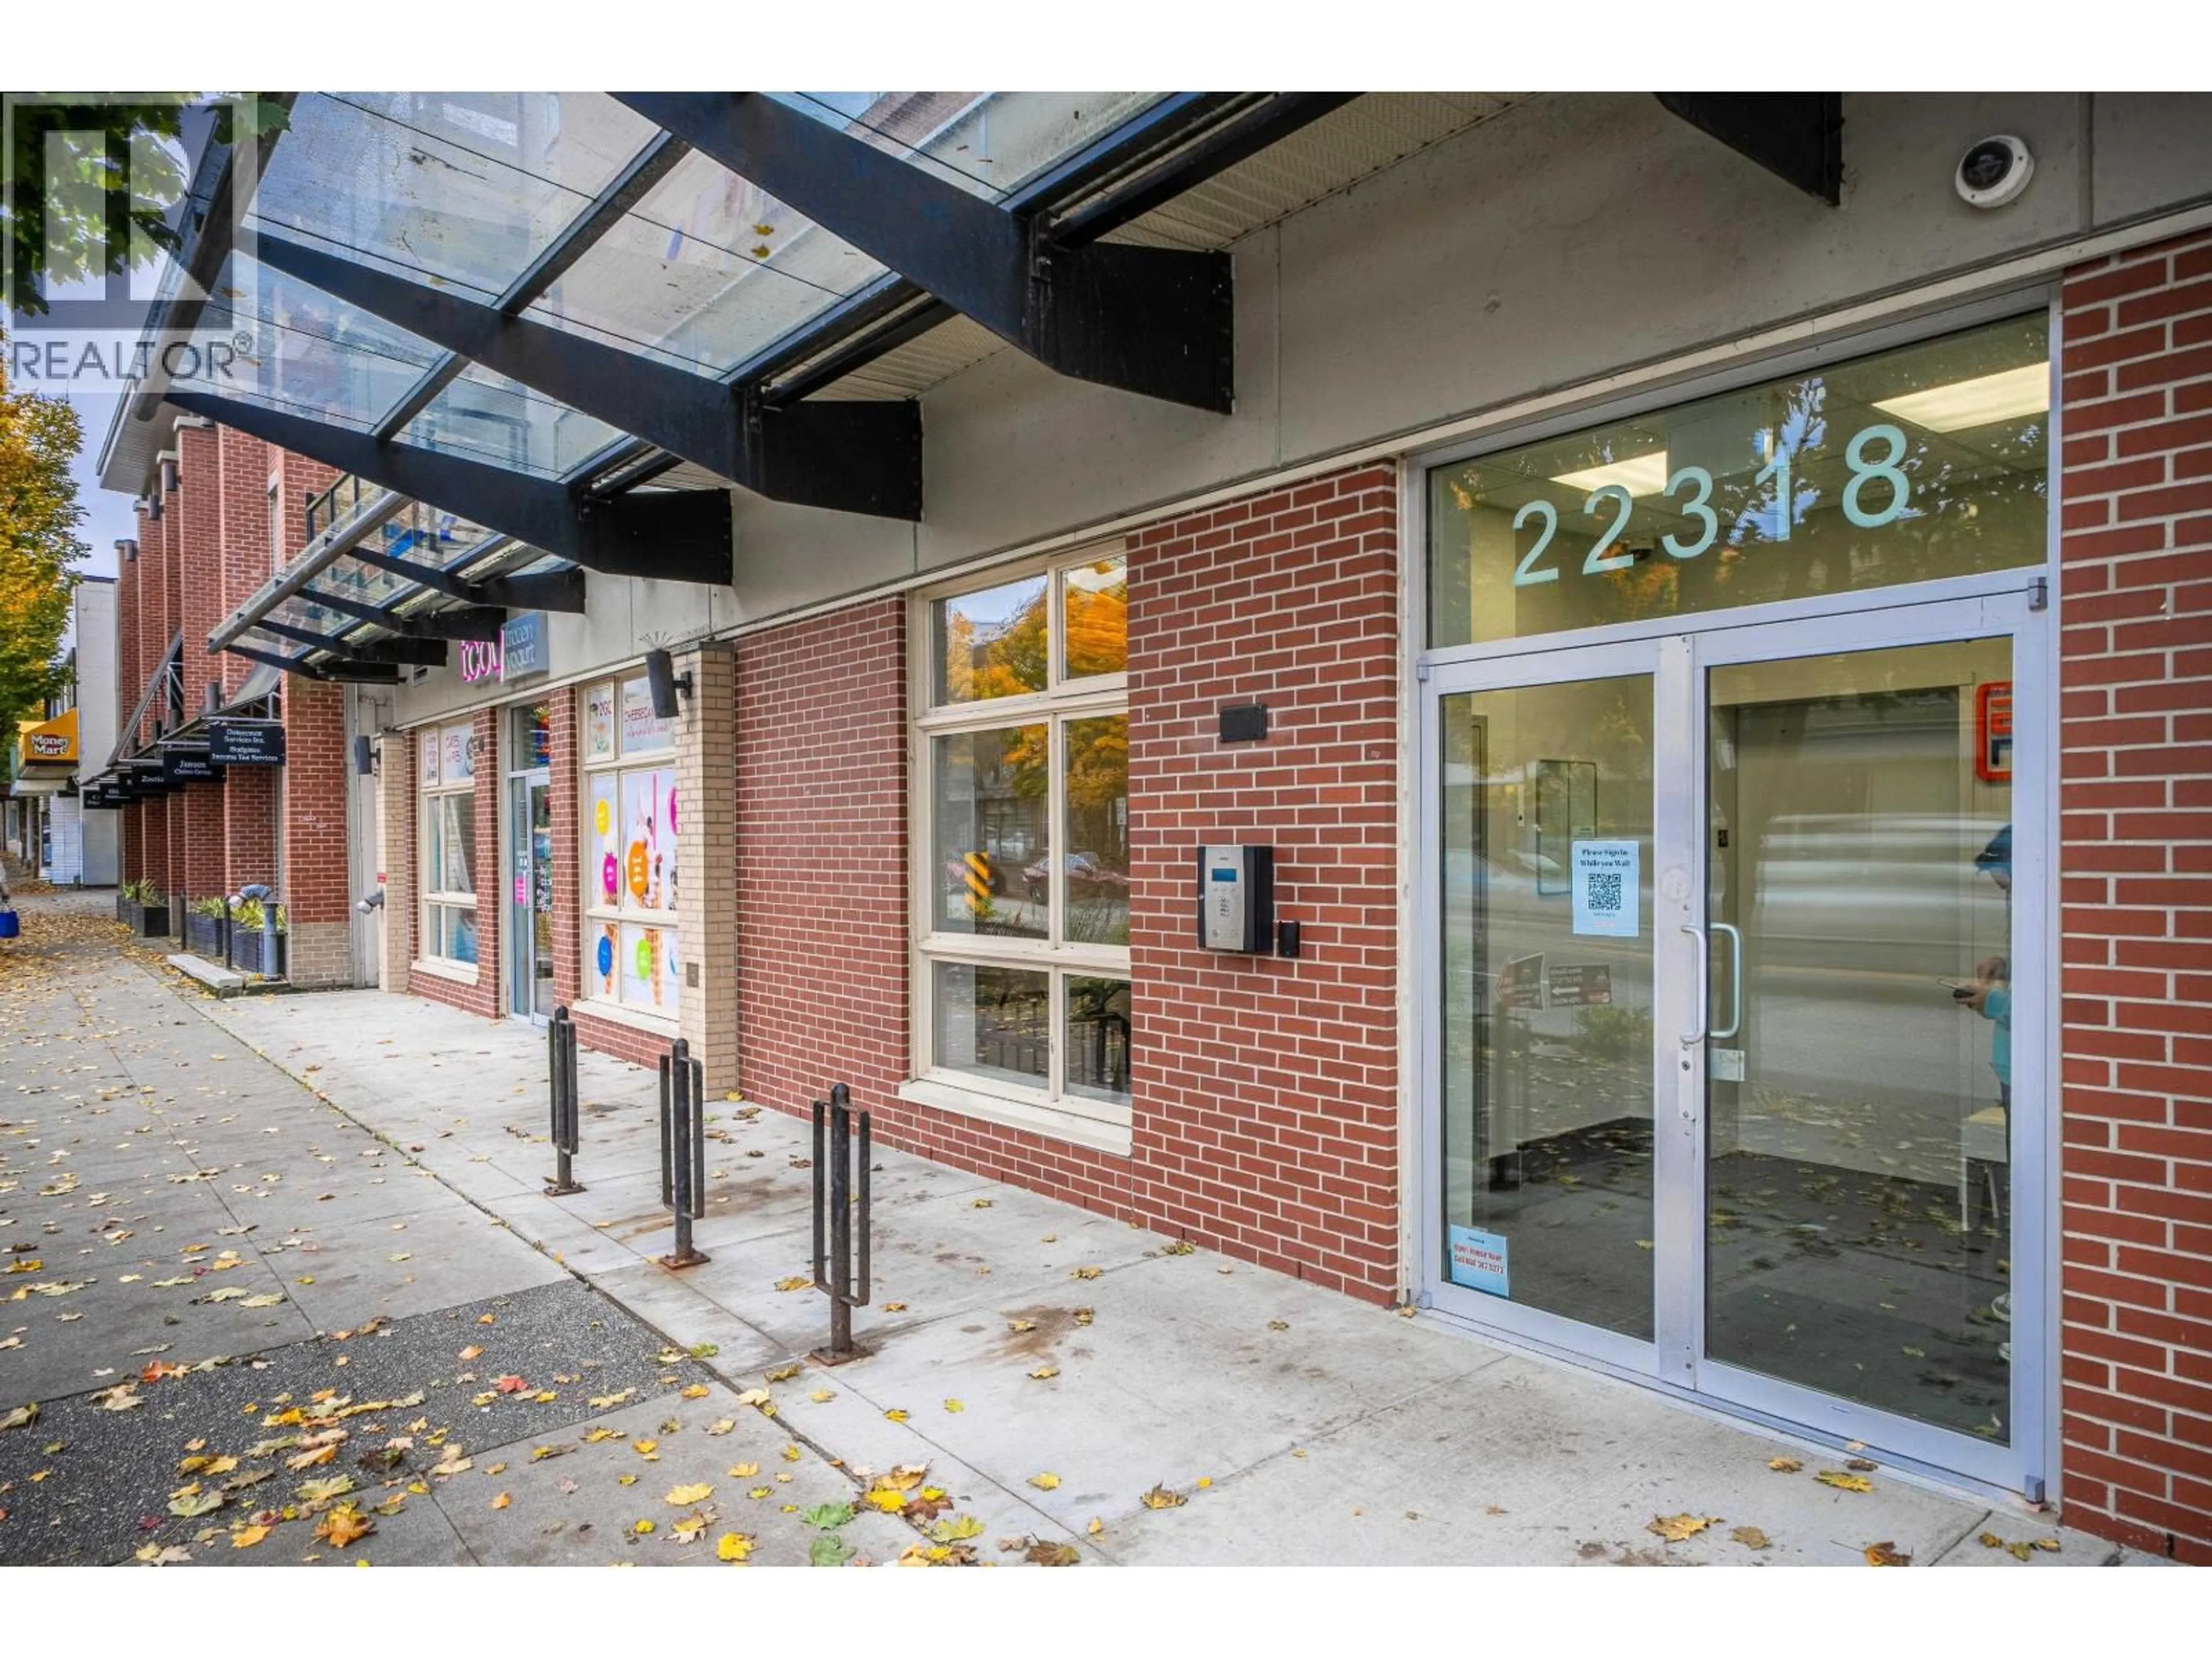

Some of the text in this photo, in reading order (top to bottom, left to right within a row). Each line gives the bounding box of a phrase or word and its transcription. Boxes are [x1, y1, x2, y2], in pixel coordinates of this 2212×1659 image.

[1513, 424, 1910, 587] 22318
[32, 734, 67, 751] Money
[34, 745, 67, 755] Mart
[1604, 849, 1619, 858] Sign
